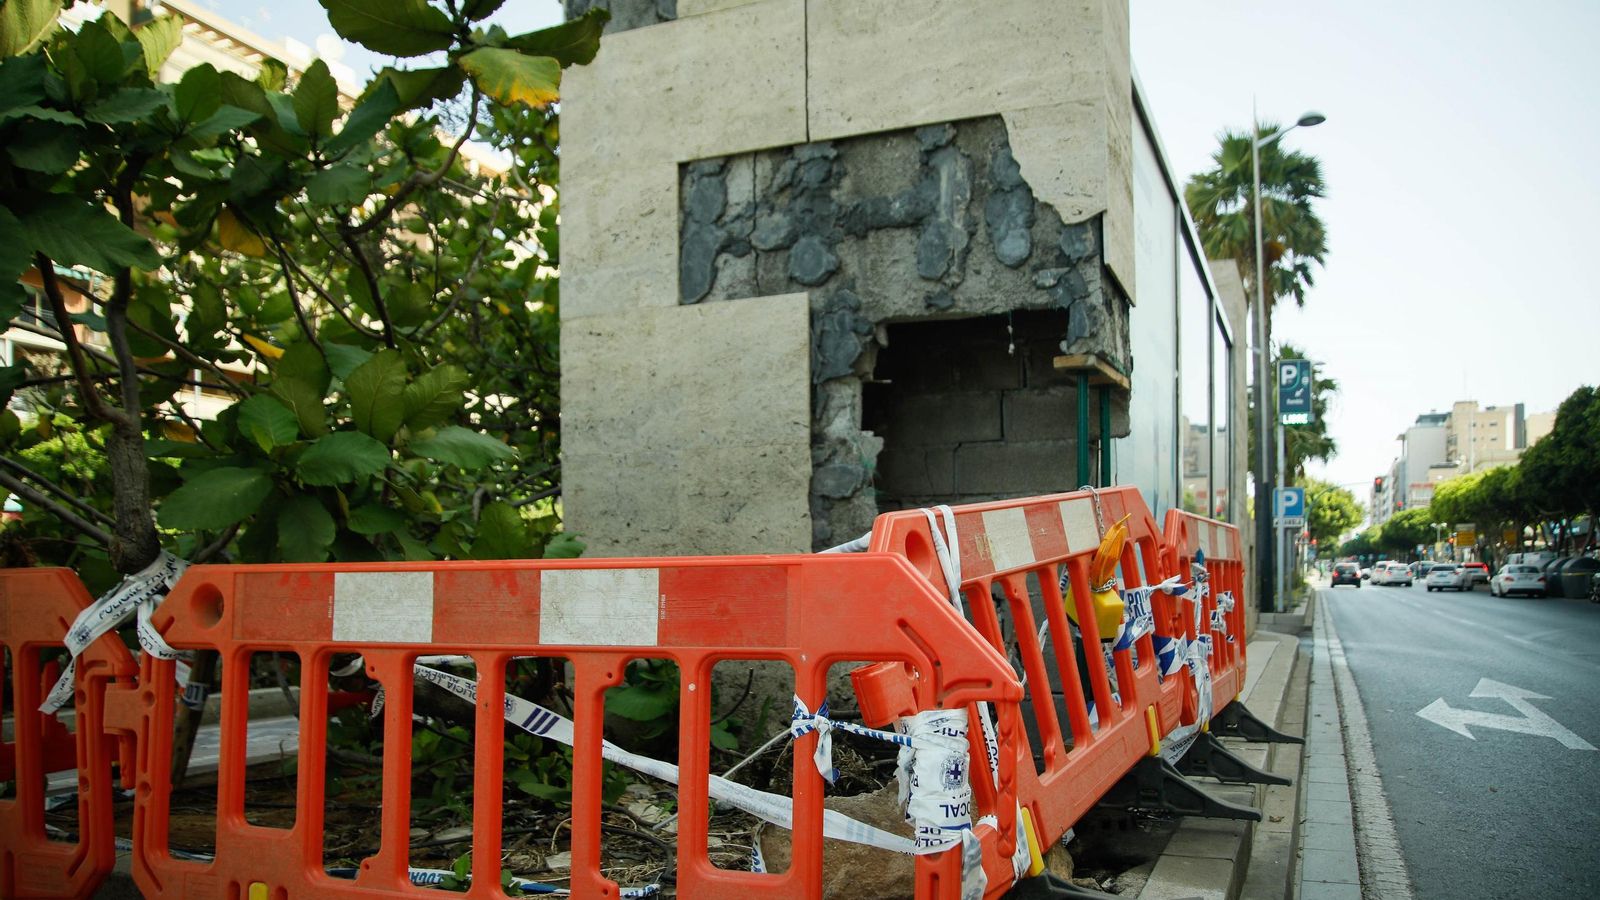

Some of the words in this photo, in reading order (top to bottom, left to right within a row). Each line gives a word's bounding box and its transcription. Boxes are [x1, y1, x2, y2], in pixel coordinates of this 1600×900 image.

[1281, 365, 1297, 385] P
[1278, 490, 1298, 515] P
[446, 680, 476, 700] OLICIA
[939, 803, 971, 818] OCAL
